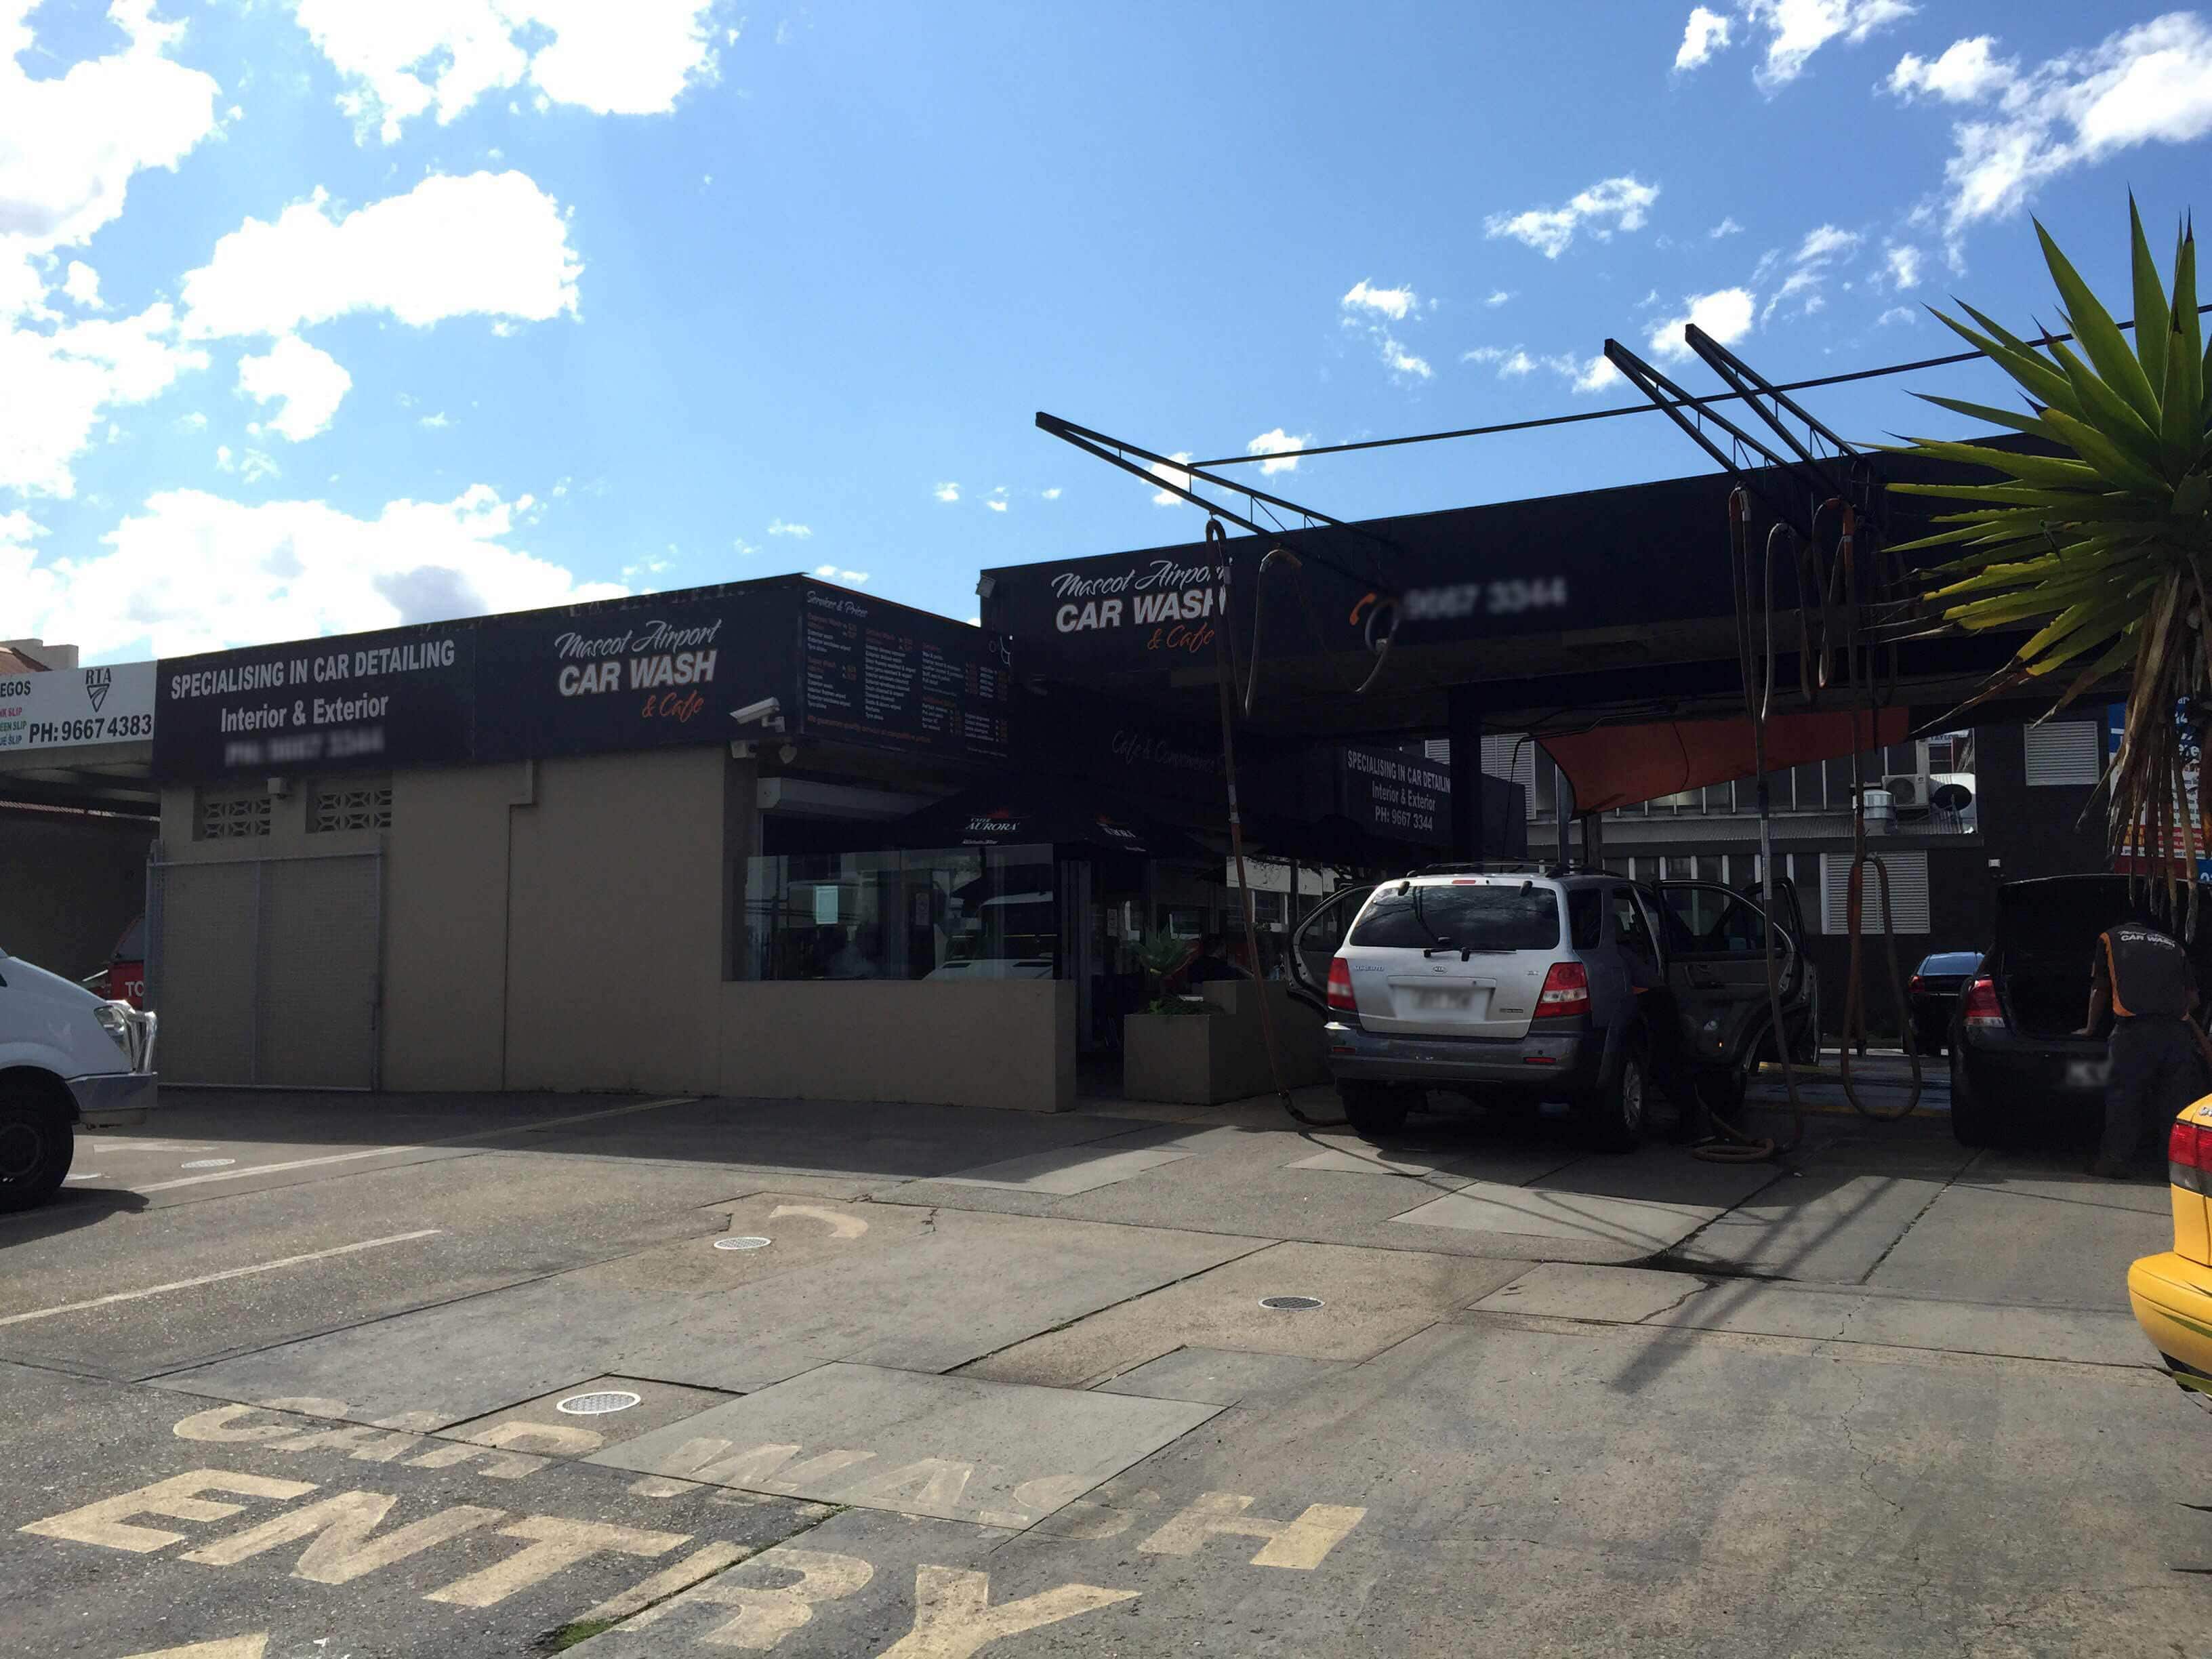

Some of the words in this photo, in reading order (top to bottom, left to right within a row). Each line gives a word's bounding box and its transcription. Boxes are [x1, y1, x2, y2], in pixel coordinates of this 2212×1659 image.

[1051, 569, 1136, 598] Mascot
[1134, 560, 1233, 590] Airpot
[1055, 599, 1123, 632] CAR
[1132, 588, 1226, 624] WASH
[554, 630, 634, 659] Mascot
[632, 619, 722, 653] Airport
[85, 668, 112, 684] RTA
[171, 661, 285, 700] SPECIALISING
[289, 659, 308, 685] IN
[314, 654, 349, 684] CAR
[354, 640, 455, 677] DETAILING
[558, 661, 621, 697] CAR
[630, 649, 718, 690] WASH
[13, 720, 27, 731] SLIP
[220, 701, 287, 733] Interior
[292, 700, 306, 726] &
[313, 693, 390, 724] Exterior
[642, 695, 657, 718] &
[659, 690, 705, 723] Cafe
[29, 722, 58, 743] PH:
[62, 718, 105, 741] 9667
[107, 714, 152, 737] 4383
[1347, 750, 1397, 780] SPECIALISING
[1398, 764, 1406, 781] IN
[1408, 766, 1422, 787] CAR
[1423, 771, 1451, 794] DETAILIN
[1372, 780, 1399, 803] Interior
[1401, 788, 1406, 805] &
[1408, 789, 1436, 812] Exterior
[1375, 805, 1389, 823] PH:
[1391, 808, 1411, 827] 9667
[1413, 813, 1433, 832] 3344
[172, 1397, 604, 1479] CAR
[16, 1469, 1142, 1659] ENTRY
